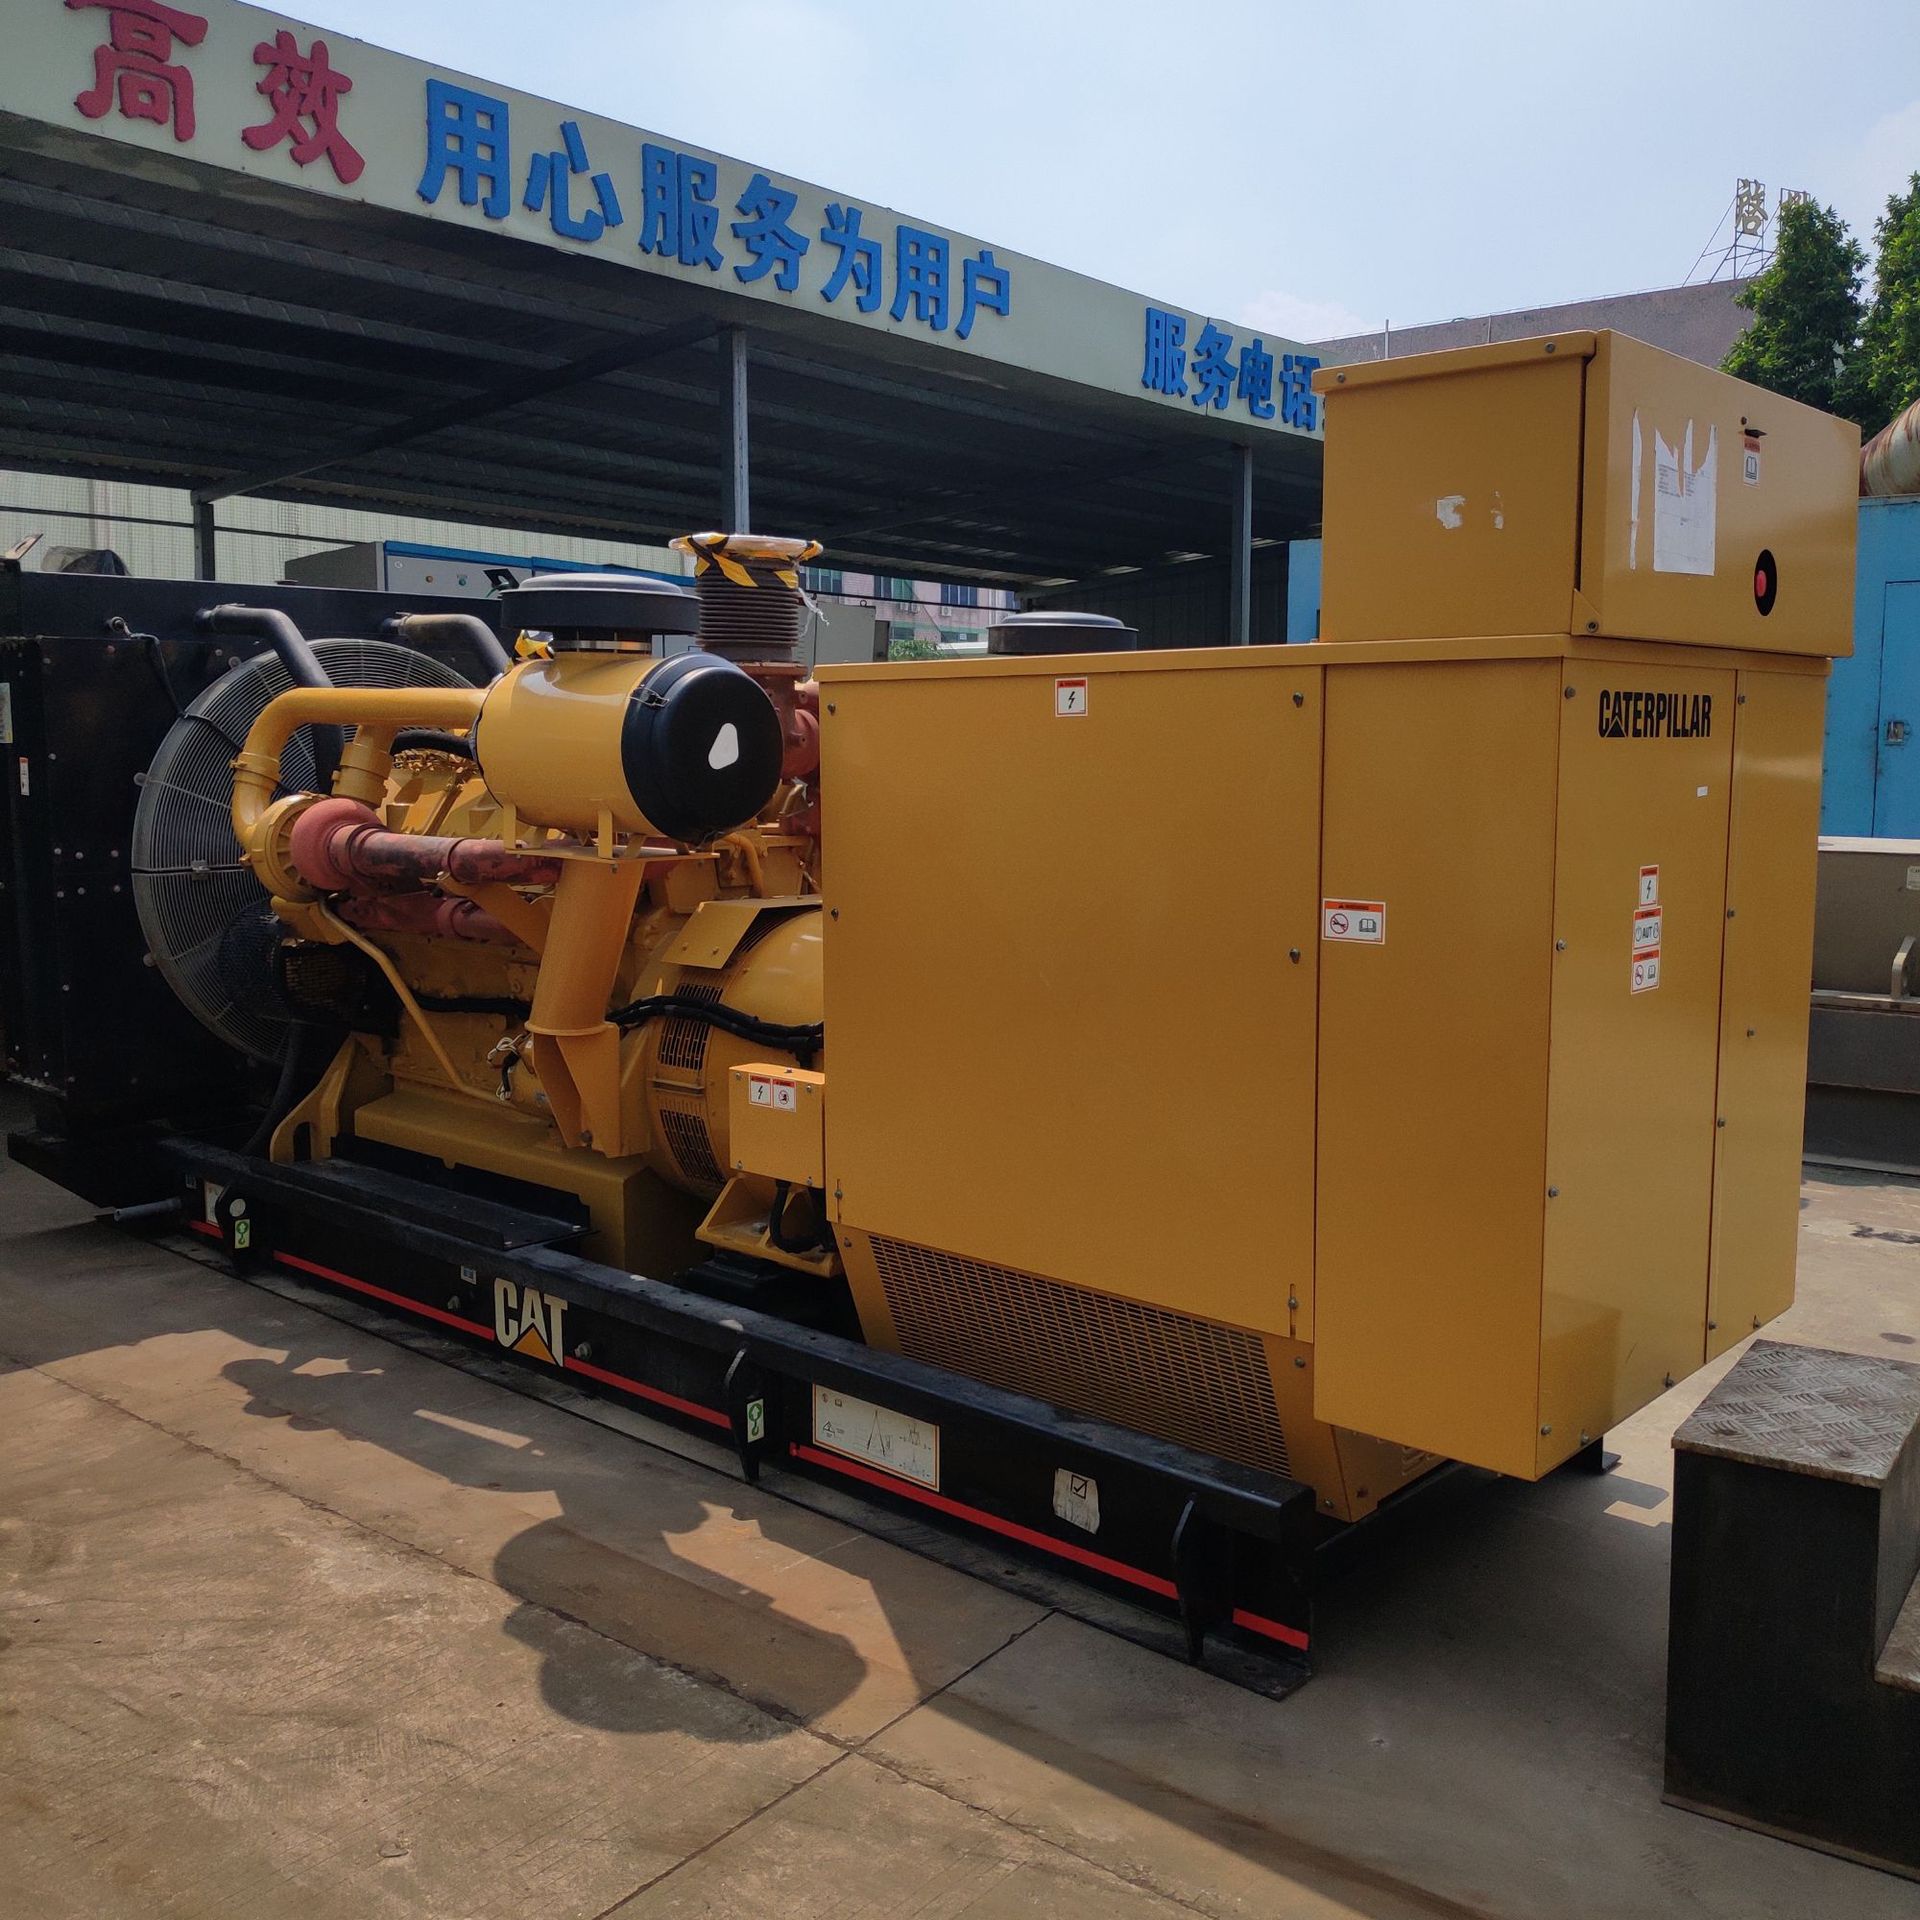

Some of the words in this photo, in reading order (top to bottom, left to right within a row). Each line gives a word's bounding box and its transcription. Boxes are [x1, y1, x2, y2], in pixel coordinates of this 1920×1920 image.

[65, 0, 365, 184] 高效
[419, 79, 1011, 339] 用心服务为用户
[1141, 307, 1320, 431] 服务电话
[1599, 689, 1712, 738] CATERPILLAR
[494, 1277, 568, 1367] CAT
